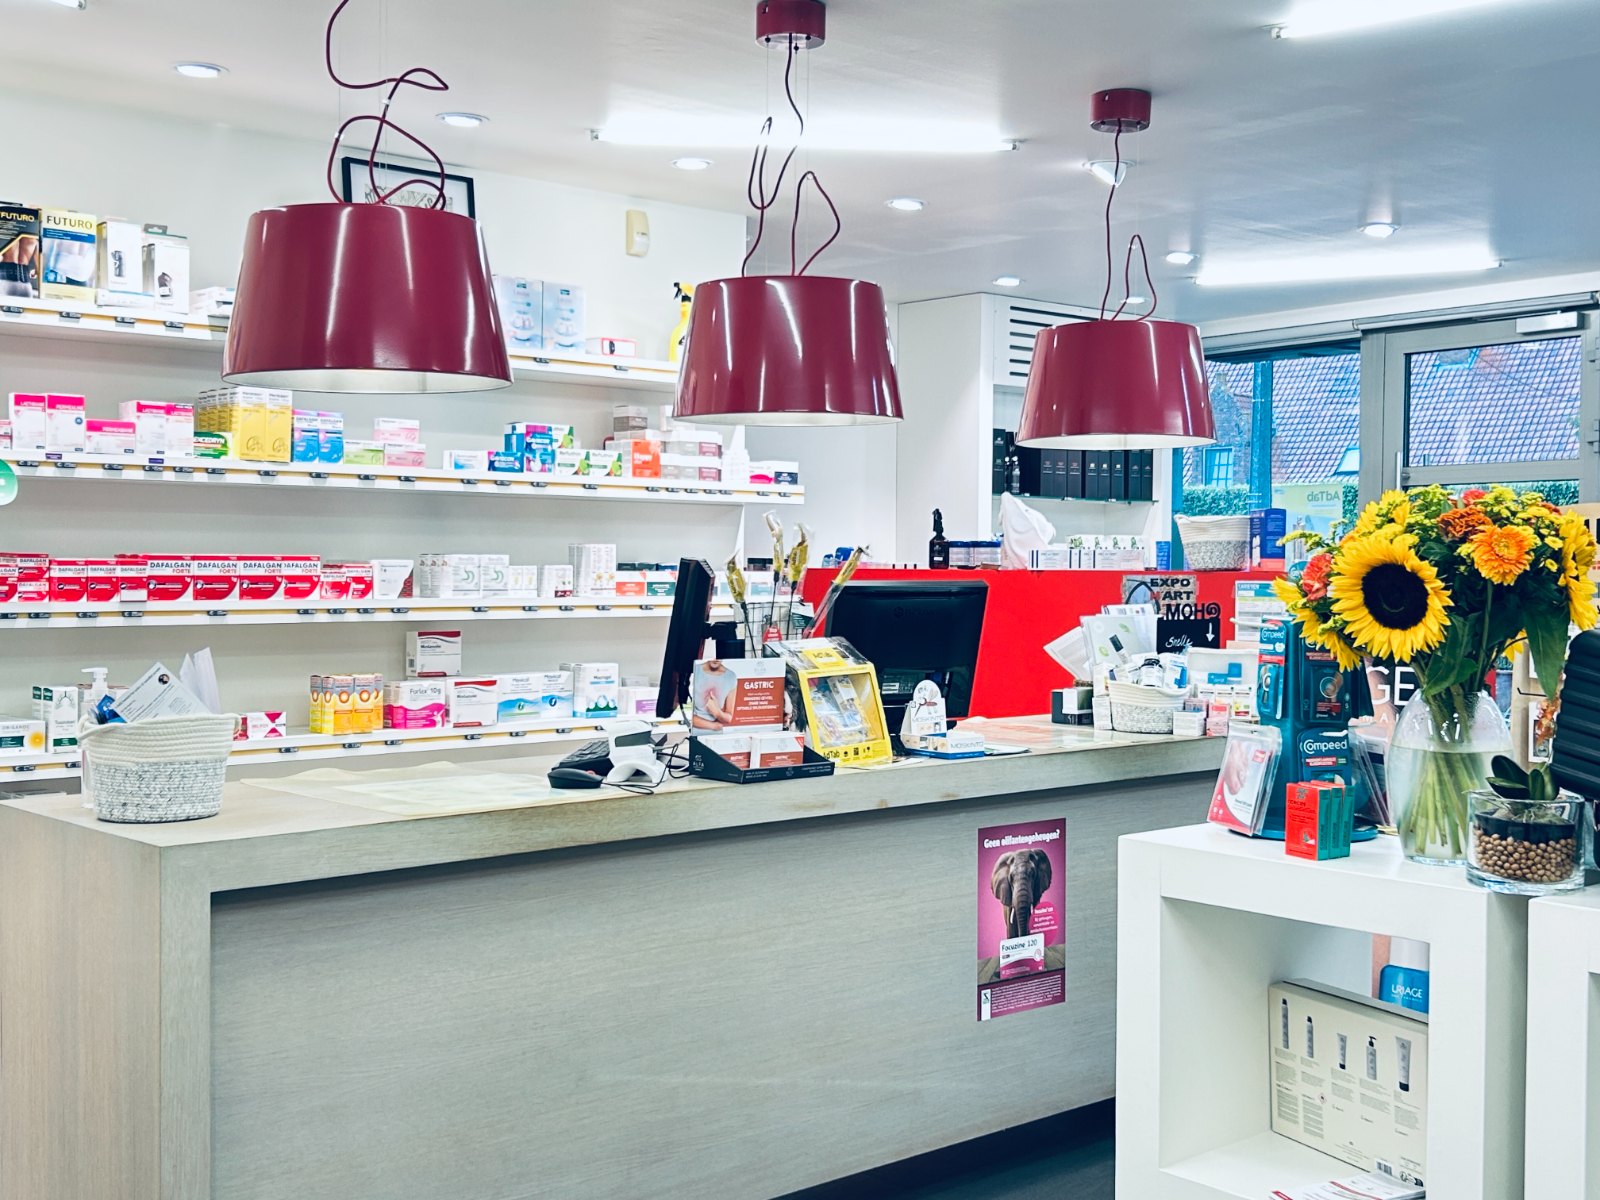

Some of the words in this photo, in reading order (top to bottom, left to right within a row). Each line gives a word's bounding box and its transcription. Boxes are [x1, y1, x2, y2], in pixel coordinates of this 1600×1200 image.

[0, 212, 35, 222] FUTURO
[46, 215, 93, 230] FUTURO
[150, 561, 192, 569] DAFALGAN
[197, 561, 238, 569] DAFALGAN
[243, 561, 282, 569] DAFALGAN
[1150, 578, 1191, 588] EXPO
[1261, 627, 1285, 641] Compeed
[744, 681, 775, 690] GASTRIC
[430, 687, 442, 695] 10g
[911, 715, 945, 723] MOSKINTO
[950, 741, 984, 749] MOSKINTO
[1303, 739, 1348, 755] Compeed
[983, 838, 1001, 849] Geen
[1001, 942, 1026, 952] Focuzine
[1027, 939, 1038, 947] 120
[1391, 983, 1423, 999] URIAGE
